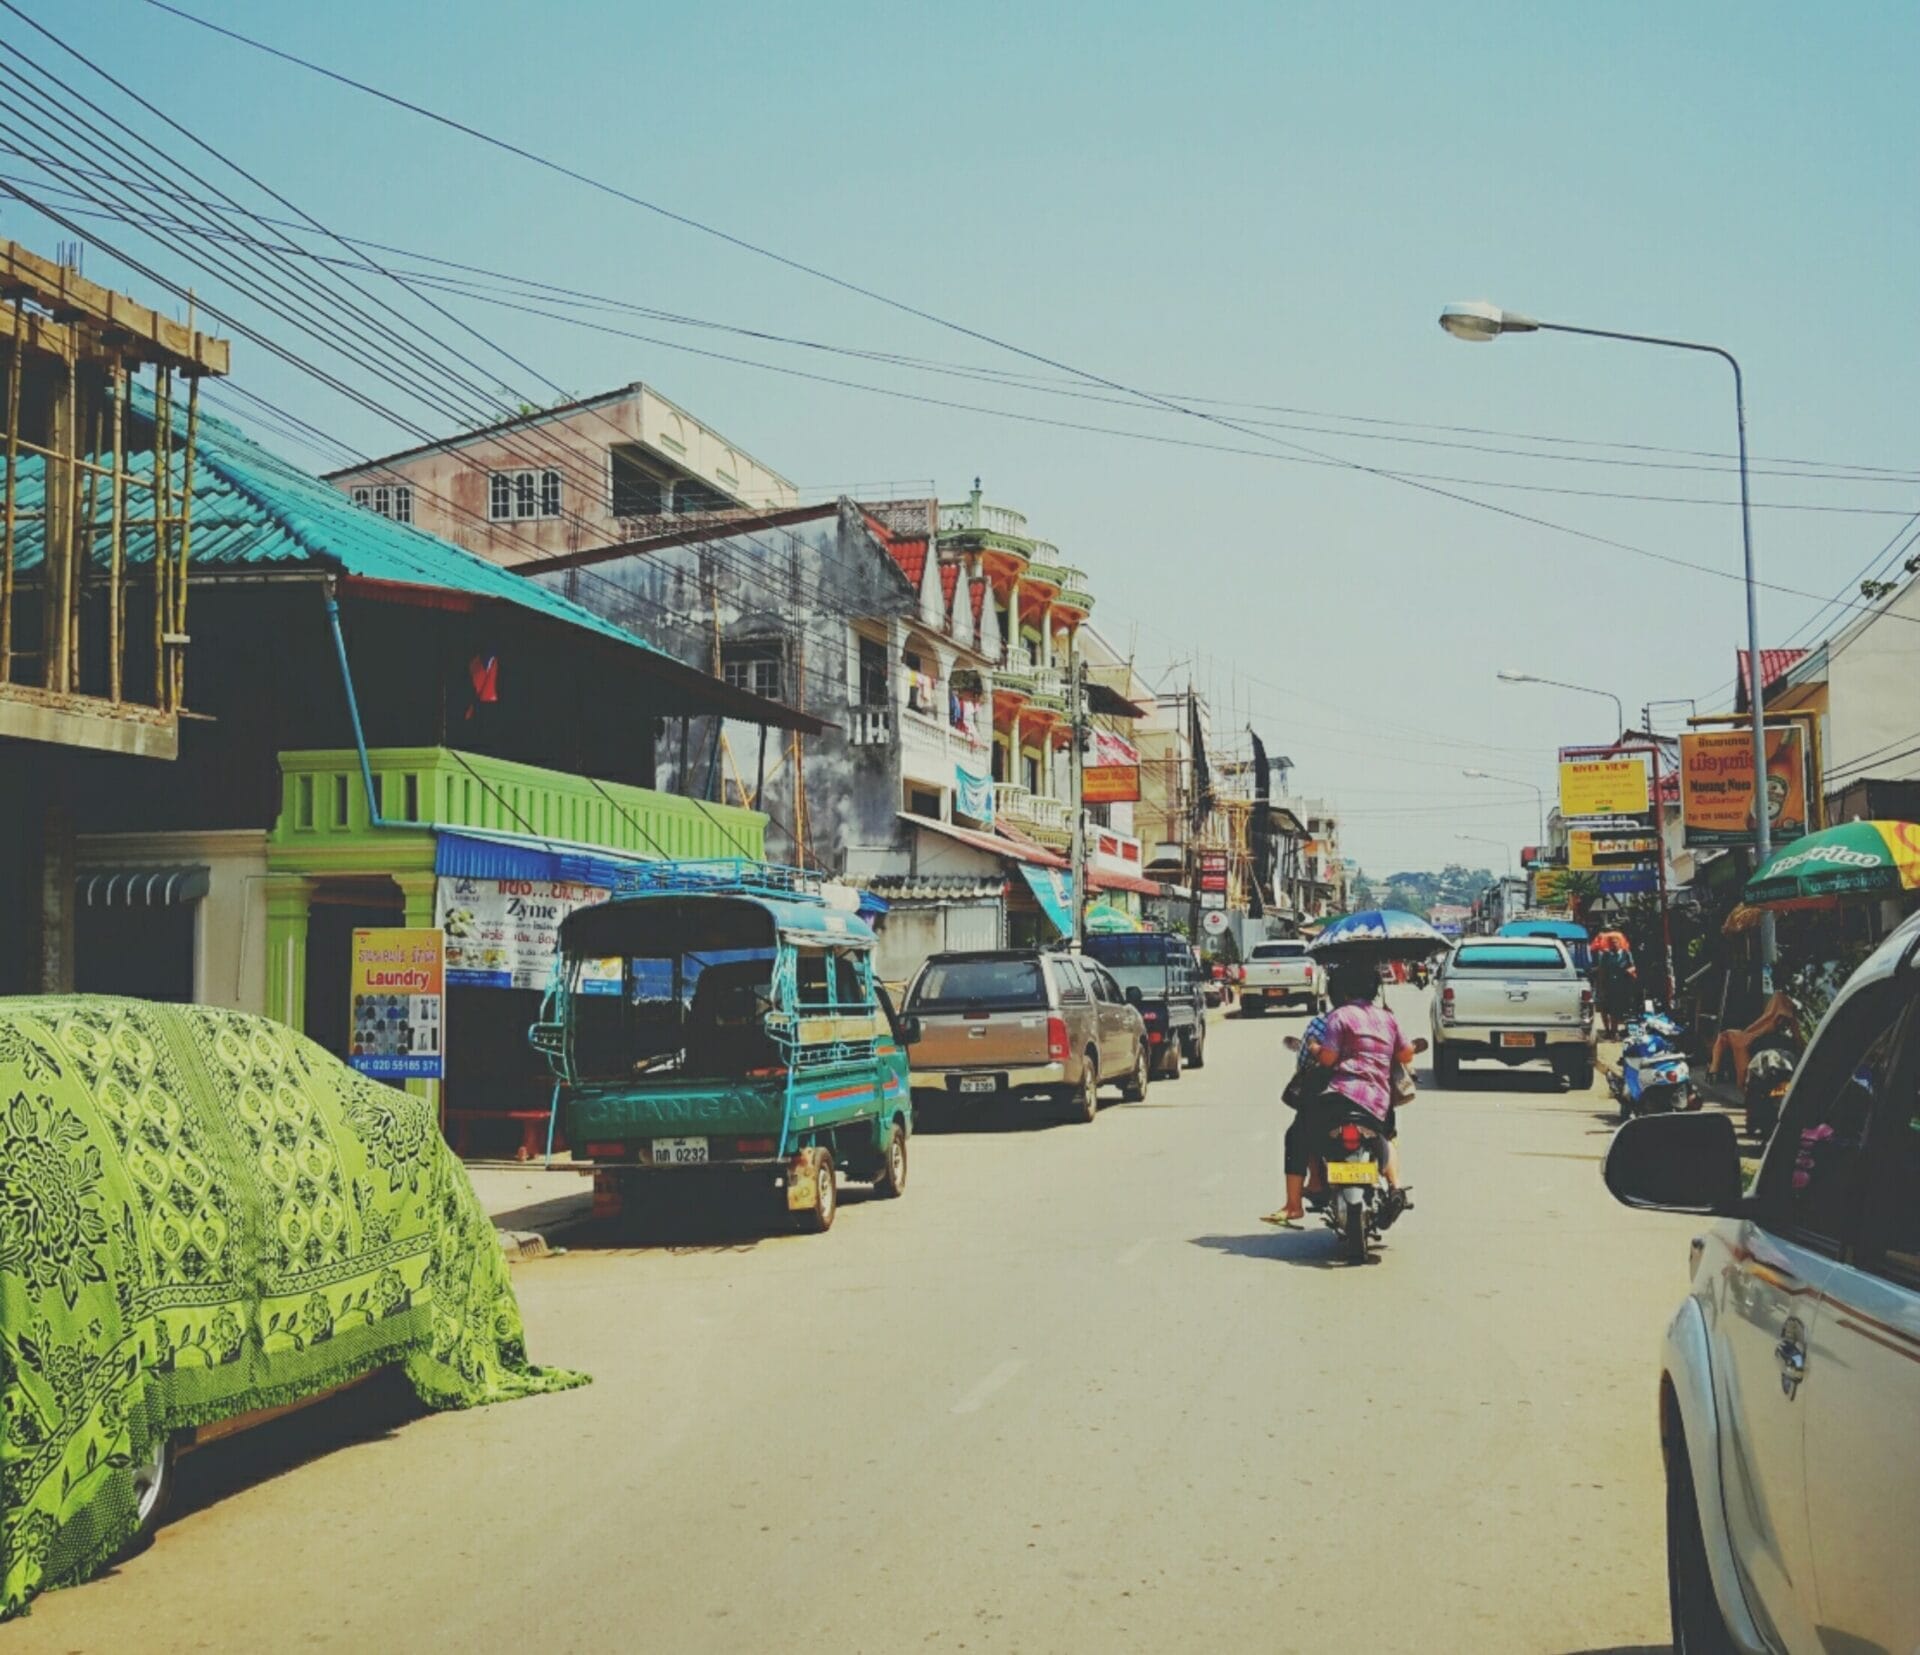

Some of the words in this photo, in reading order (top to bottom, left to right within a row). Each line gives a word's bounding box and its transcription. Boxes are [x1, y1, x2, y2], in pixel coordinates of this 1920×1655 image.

[506, 898, 557, 921] Zyme
[366, 968, 430, 991] Laundry
[372, 1059, 391, 1071] 020
[676, 1147, 706, 1161] 0232
